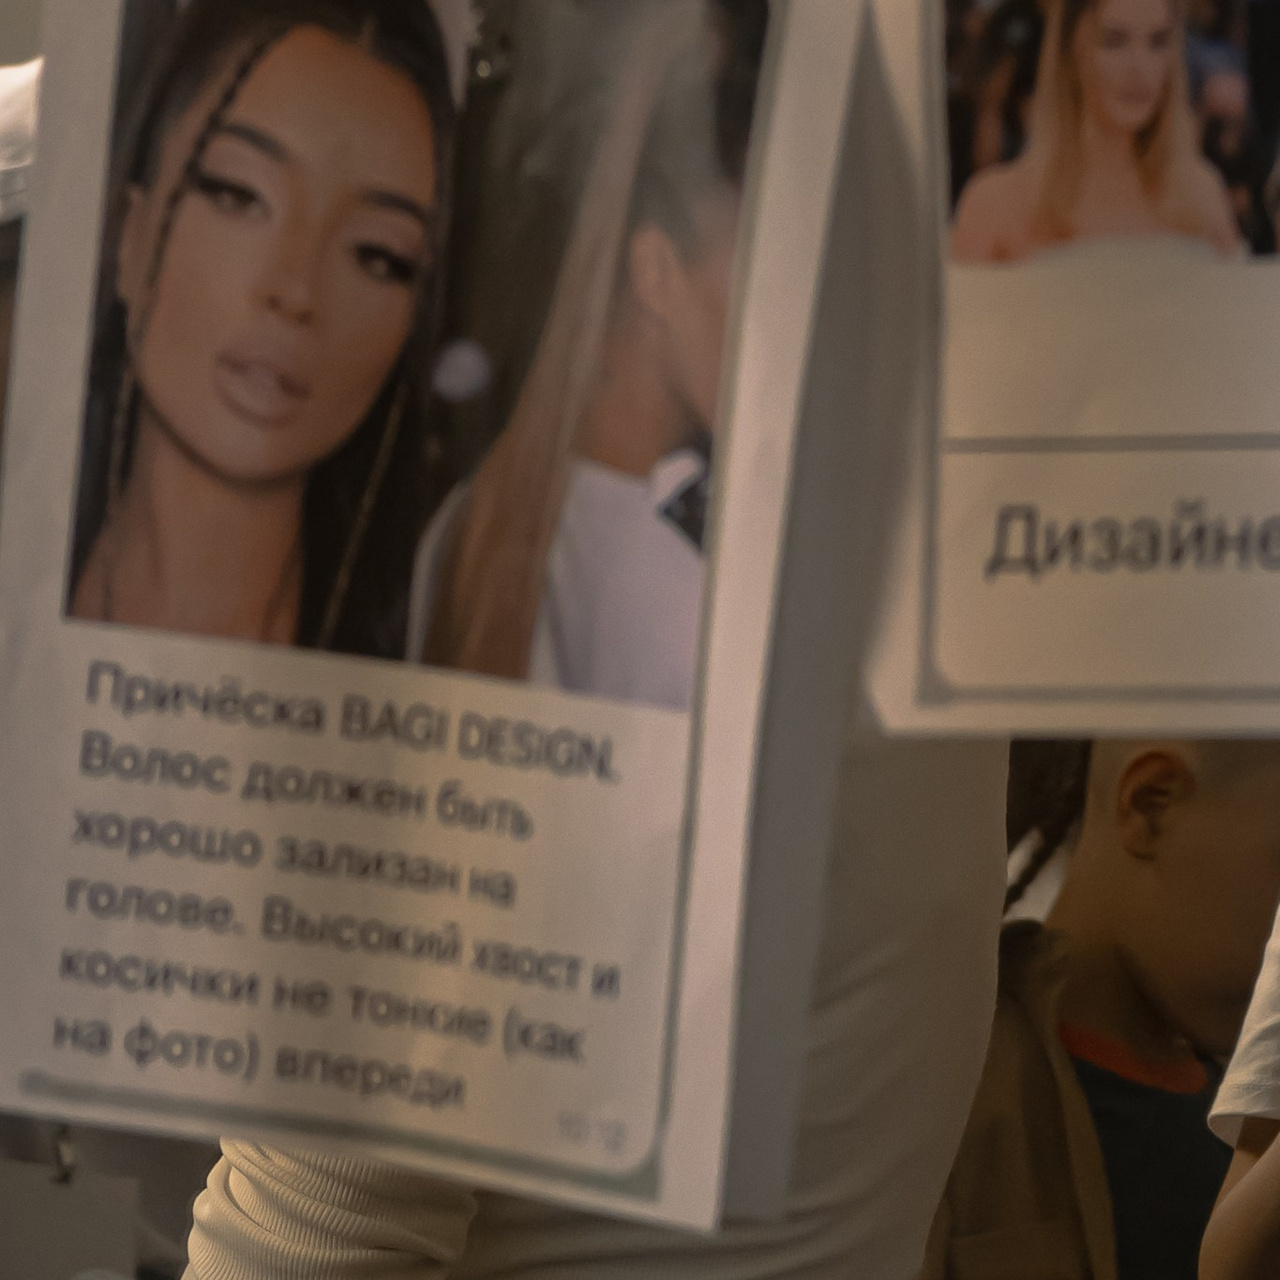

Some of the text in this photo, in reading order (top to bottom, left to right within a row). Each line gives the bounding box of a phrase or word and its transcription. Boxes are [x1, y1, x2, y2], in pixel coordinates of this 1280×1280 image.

[87, 659, 324, 733] Причёска
[340, 694, 446, 751] BAGI
[80, 729, 532, 841] Волос должен быть
[72, 808, 516, 908] хорошо зализан на
[66, 878, 621, 999] голове. Высокий хвост и
[59, 946, 584, 1064] косички не тонкие (как
[53, 1013, 465, 1110] на фото) впереди
